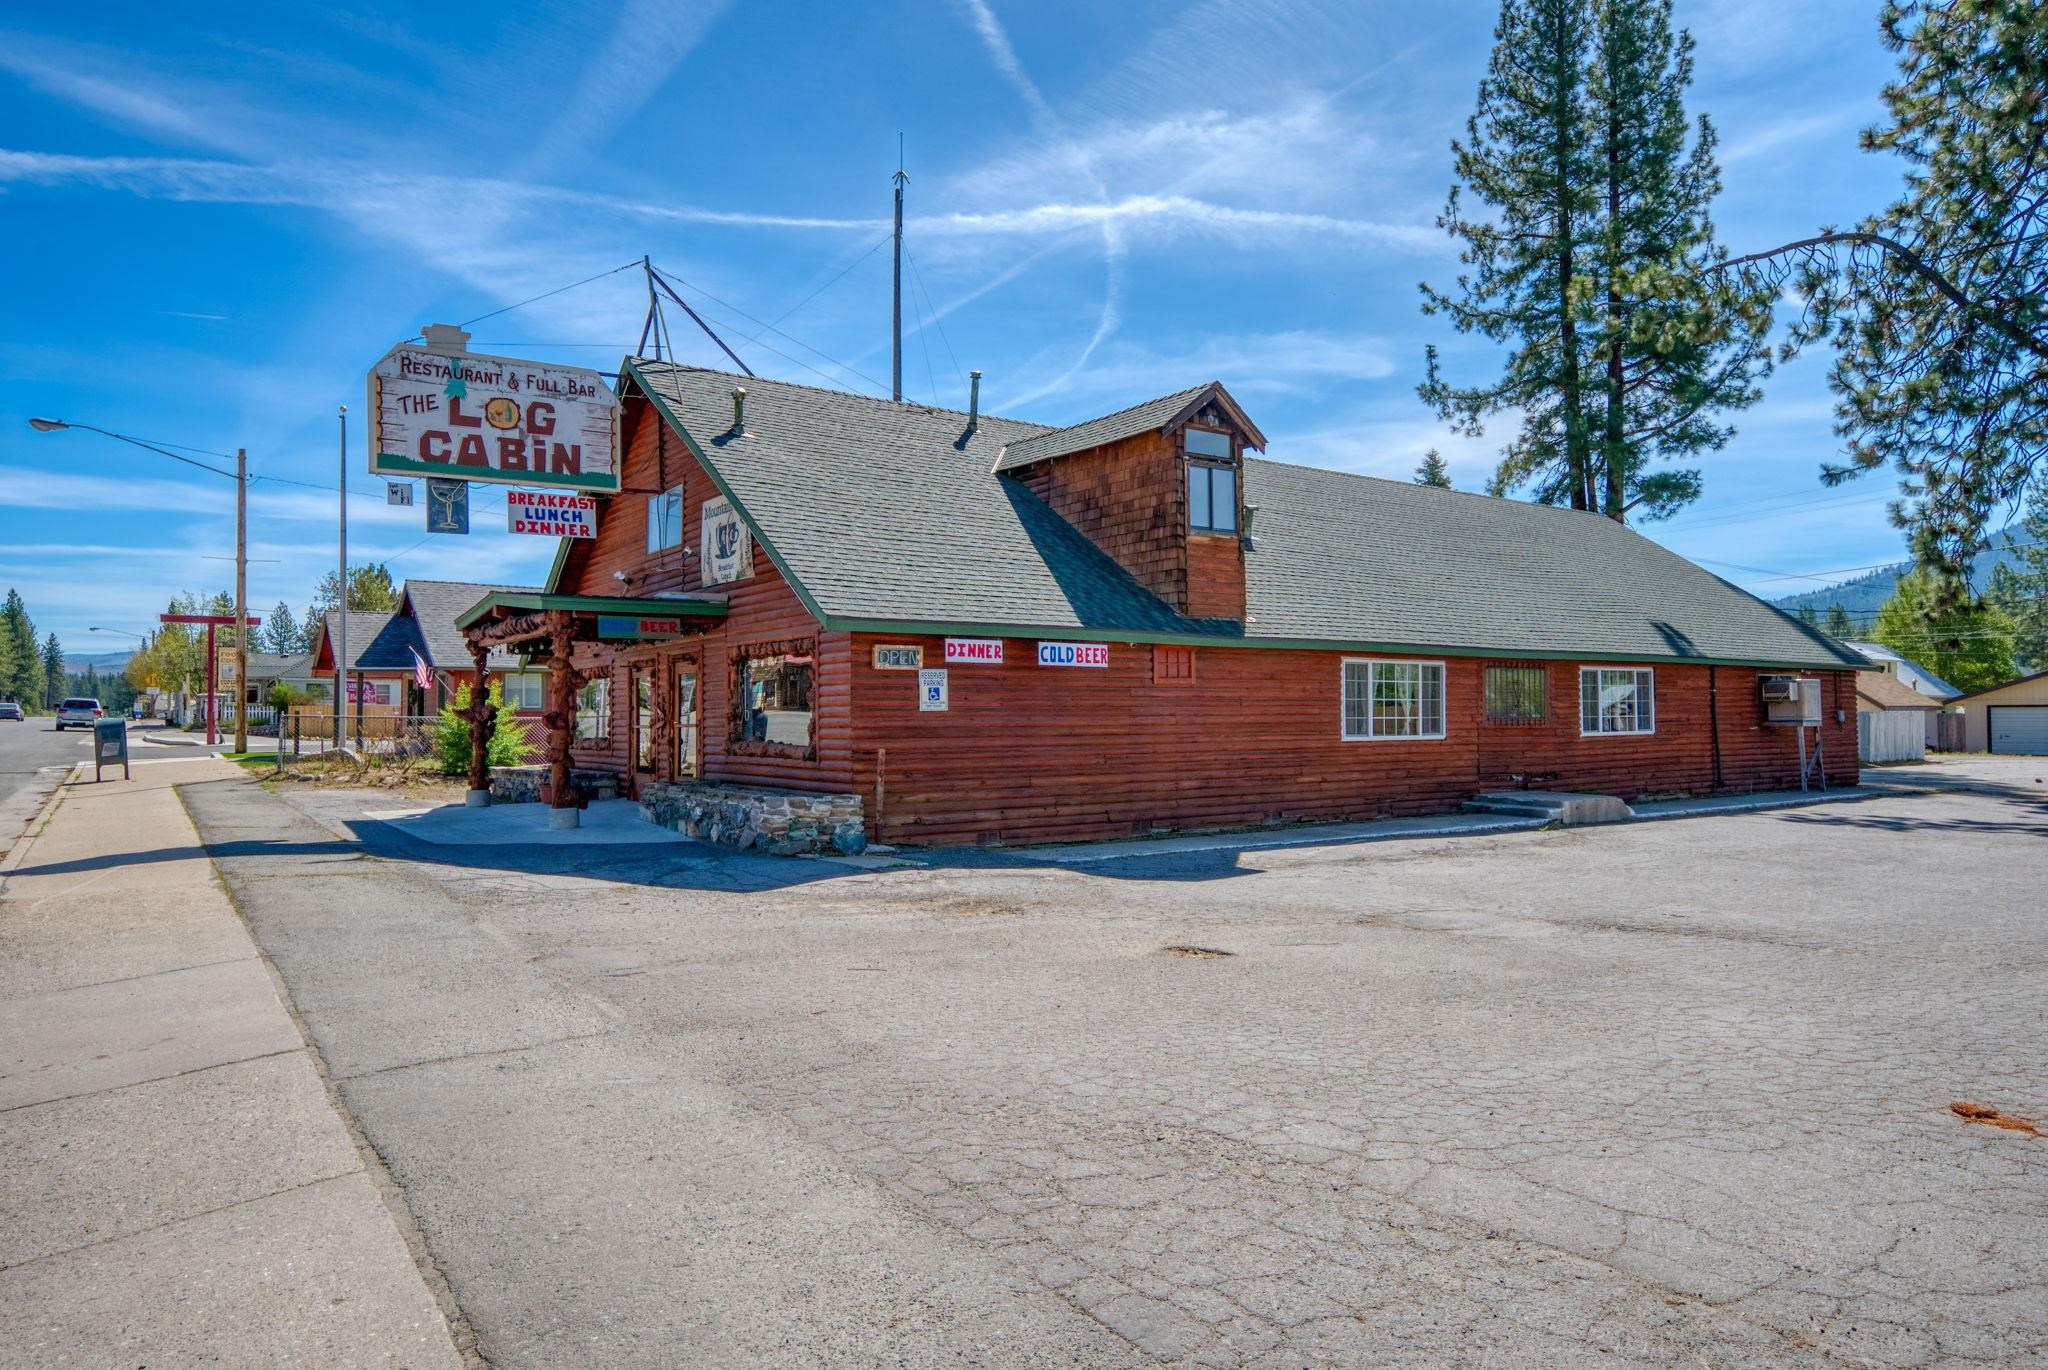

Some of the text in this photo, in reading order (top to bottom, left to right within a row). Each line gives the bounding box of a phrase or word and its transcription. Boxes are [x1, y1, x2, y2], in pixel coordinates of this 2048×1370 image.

[400, 356, 596, 398] RESTAURANT & FULL BAR
[396, 394, 556, 436] THE LOG
[508, 492, 596, 510] BREAKFAST
[524, 507, 583, 522] LUNCH
[515, 519, 590, 536] DINNER
[640, 620, 678, 633] BEER
[879, 650, 918, 665] OPEN
[947, 643, 1002, 660] DINNER
[1040, 645, 1108, 664] COLD BEER
[921, 671, 945, 680] RESERVED
[923, 679, 944, 687] PARKING
